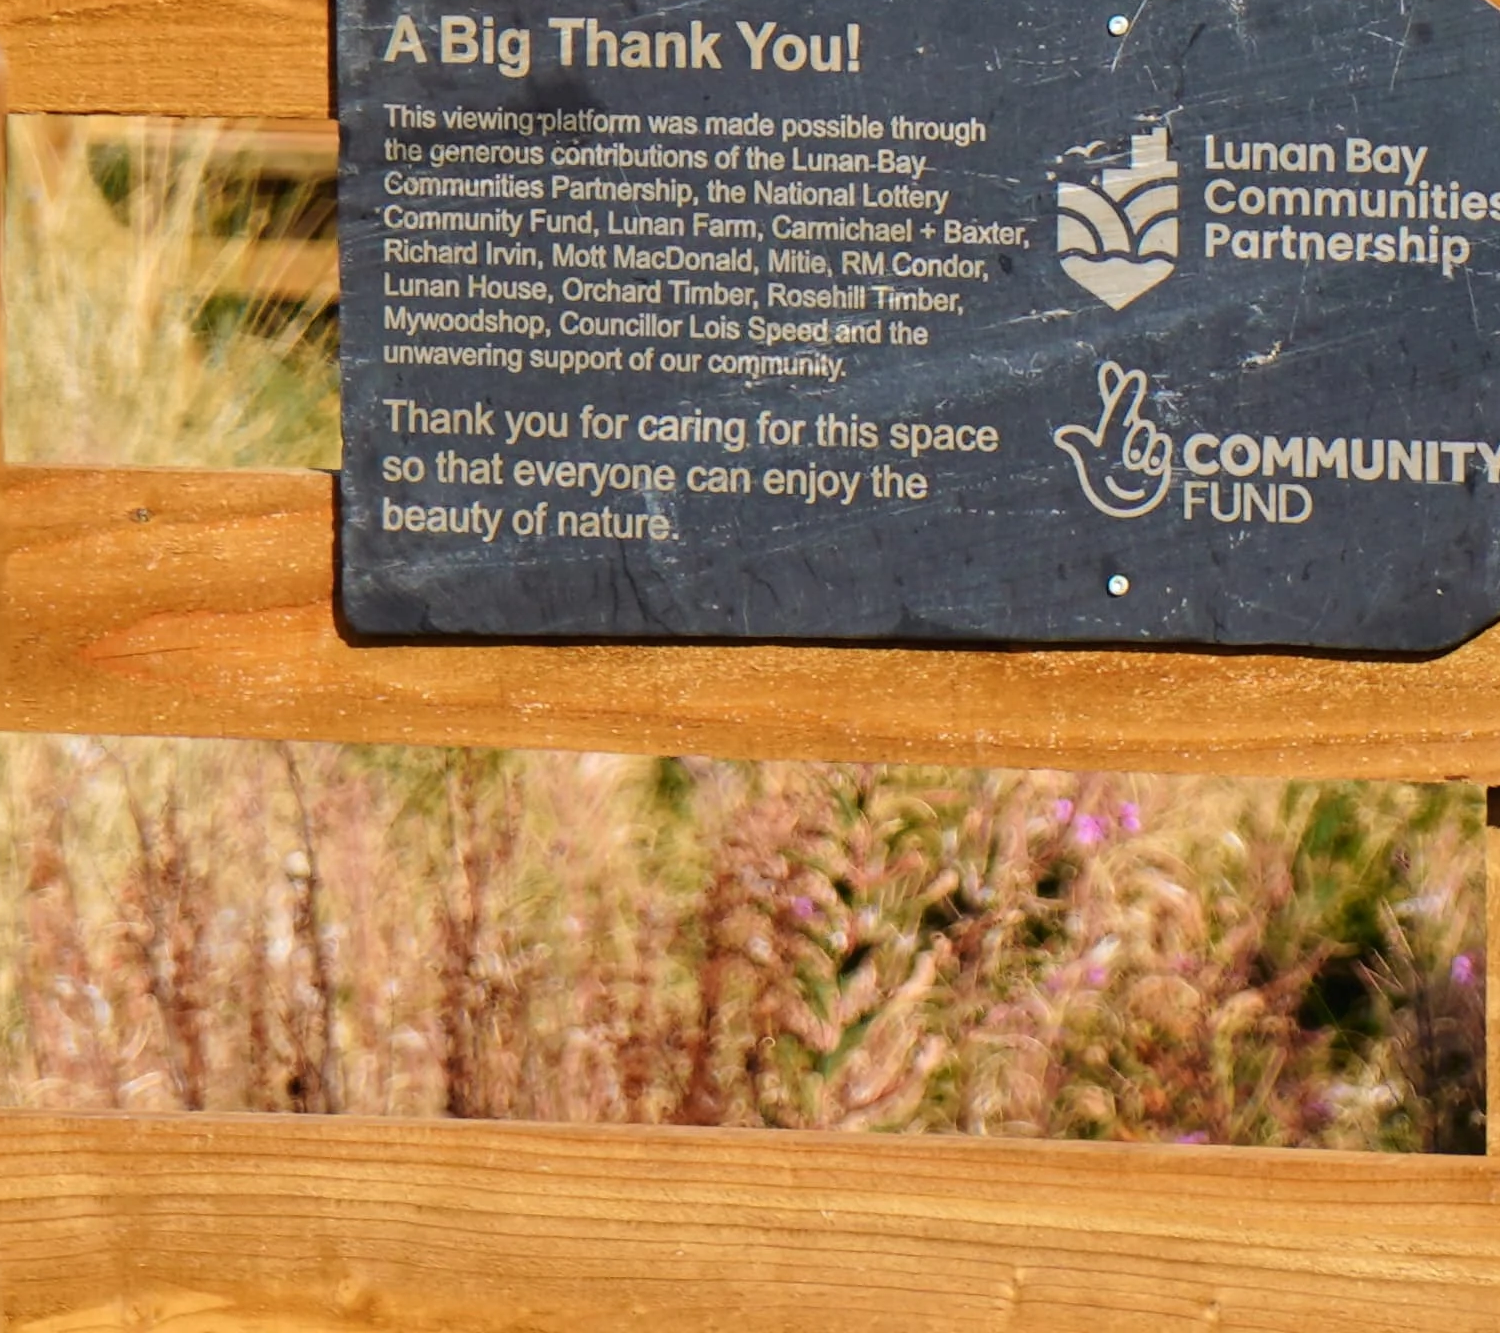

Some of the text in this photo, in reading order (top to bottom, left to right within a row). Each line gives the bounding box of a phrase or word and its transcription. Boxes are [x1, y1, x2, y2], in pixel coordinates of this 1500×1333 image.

[383, 15, 860, 77] A Big Thank You!
[383, 104, 986, 147] This viewing platform was made possible through
[384, 139, 927, 179] the generous contributions of the Lunan Bay
[1205, 135, 1428, 185] Lunan Bay
[384, 171, 949, 214] Communities Partnership, the National Lottery
[384, 205, 1030, 249] Community Fund, Lunan Farm, Carmichael + Baxter,
[384, 239, 989, 281] Richard Irvin, Mott MacDonald, Mitie, RM Condor,
[1205, 223, 1471, 276] Partnership
[384, 272, 964, 314] Lunan House, Orchard Timber, Rosehill Timber,
[384, 306, 928, 345] Mywoodshop, Councillor Lois Speed and the
[384, 343, 846, 382] unwavering support of our community.
[382, 399, 1000, 457] Thank you for caring for this space
[382, 451, 928, 505] so that everyone can enjoy the
[382, 497, 679, 542] beauty of nature.
[1183, 481, 1312, 524] FUND
